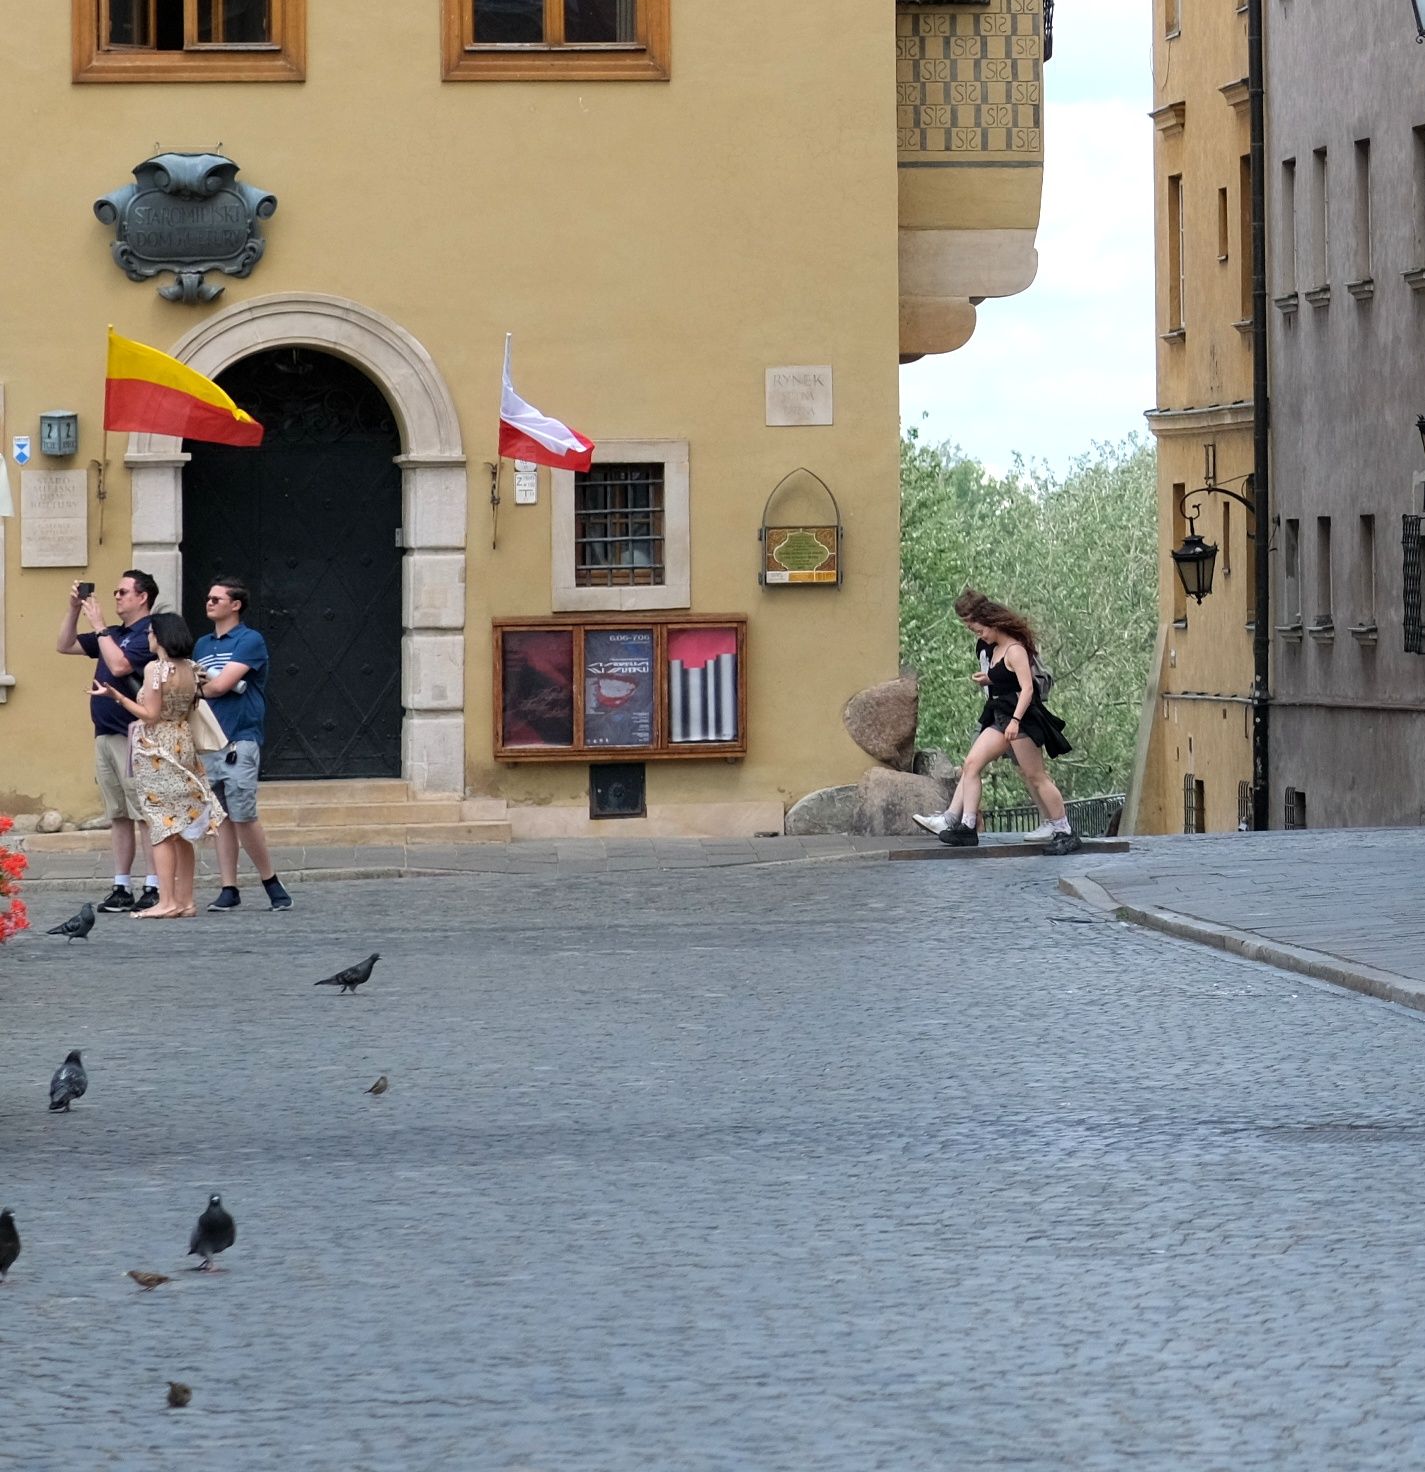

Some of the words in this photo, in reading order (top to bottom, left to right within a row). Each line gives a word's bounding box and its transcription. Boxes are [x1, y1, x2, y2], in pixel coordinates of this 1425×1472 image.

[773, 374, 825, 387] RYNEK
[46, 422, 52, 439] 2
[65, 421, 72, 438] 2
